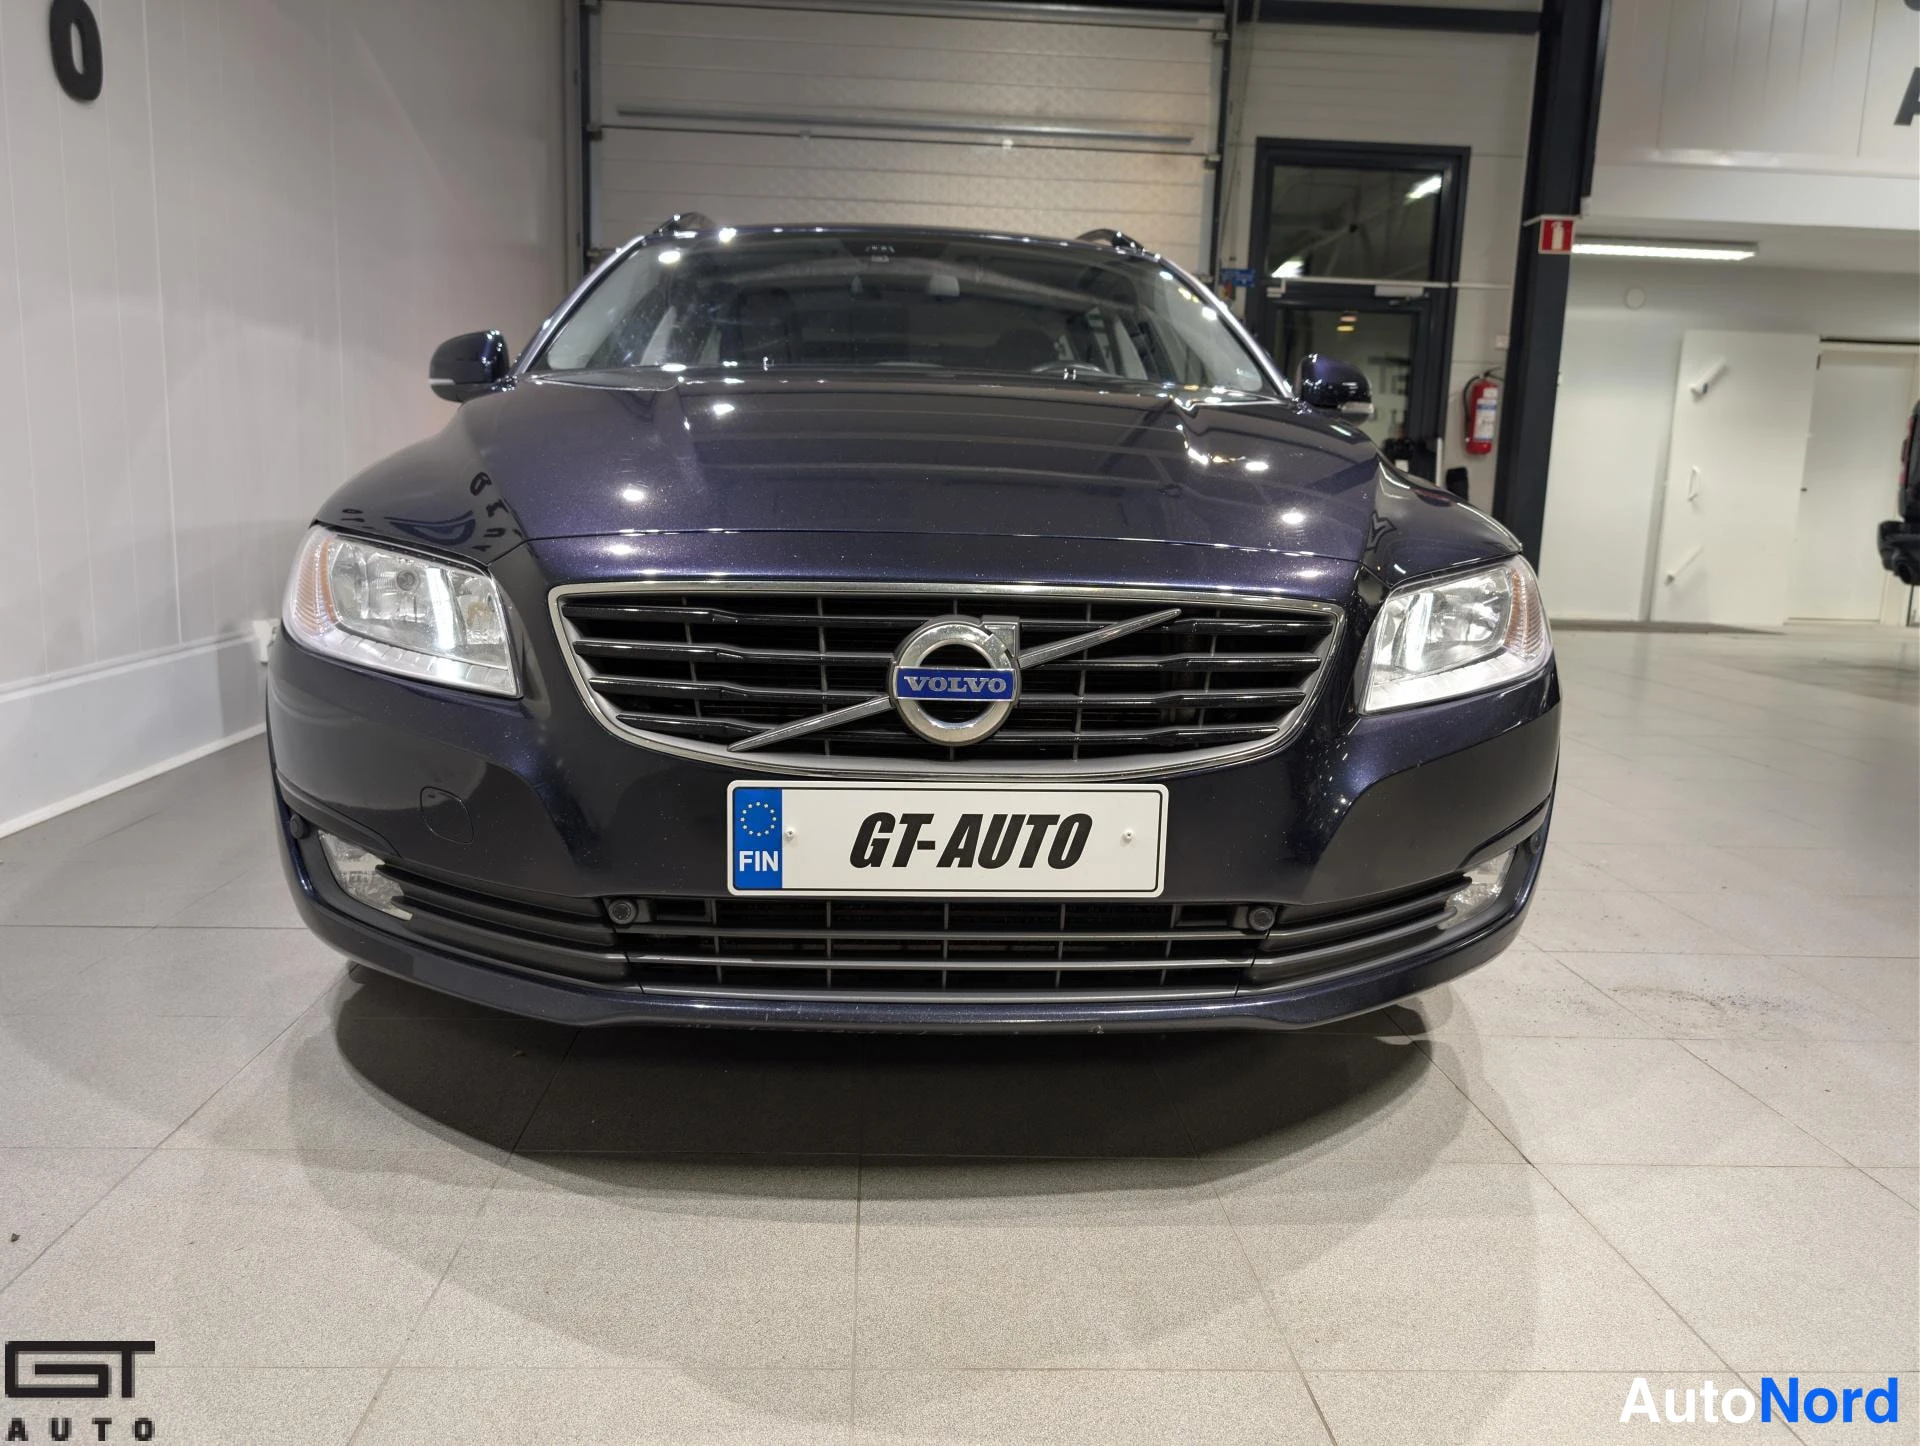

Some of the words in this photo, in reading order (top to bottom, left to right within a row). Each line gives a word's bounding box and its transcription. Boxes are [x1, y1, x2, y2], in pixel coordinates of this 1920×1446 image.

[904, 676, 1007, 693] VOLVO
[739, 850, 779, 872] FIN
[850, 812, 1093, 869] GT-AUTO
